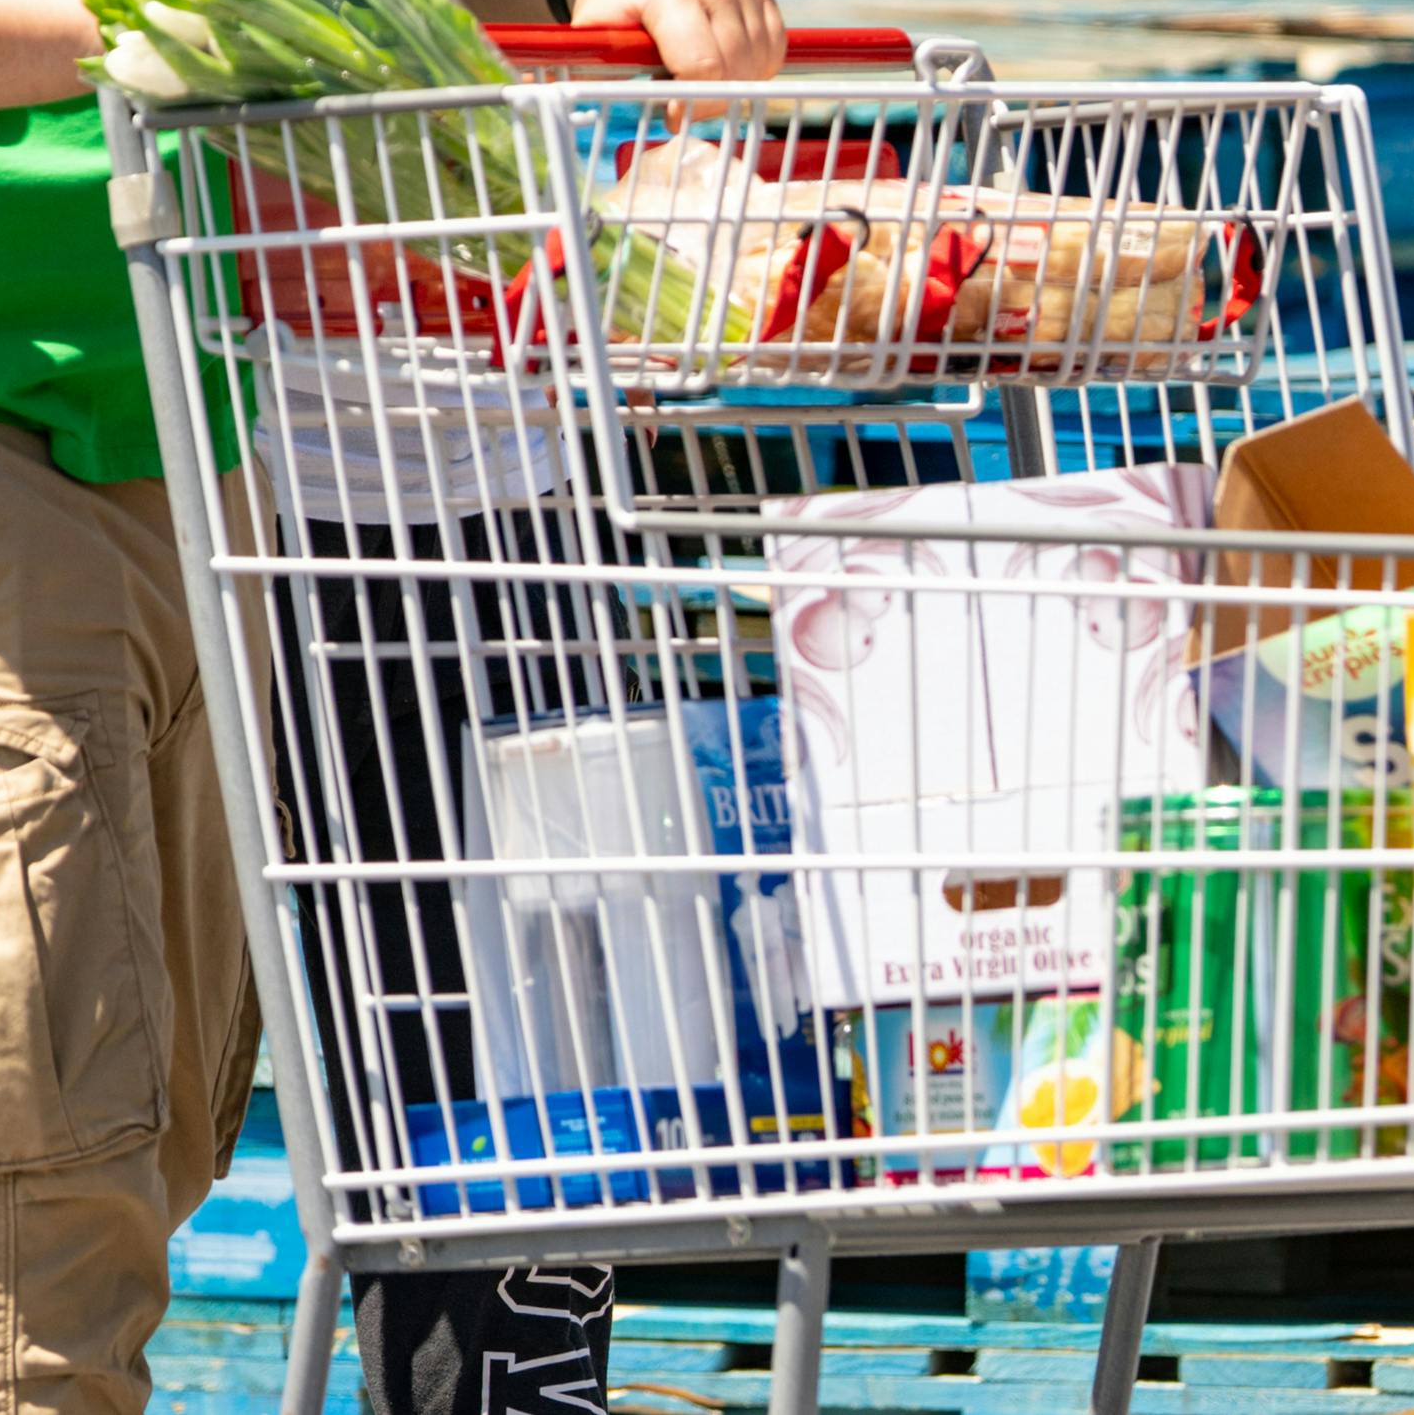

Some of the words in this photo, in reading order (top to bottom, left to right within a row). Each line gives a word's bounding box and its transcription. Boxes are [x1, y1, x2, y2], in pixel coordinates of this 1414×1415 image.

[711, 782, 794, 829] BRIT
[883, 960, 944, 985] Exa
[1033, 950, 1092, 972] Olve
